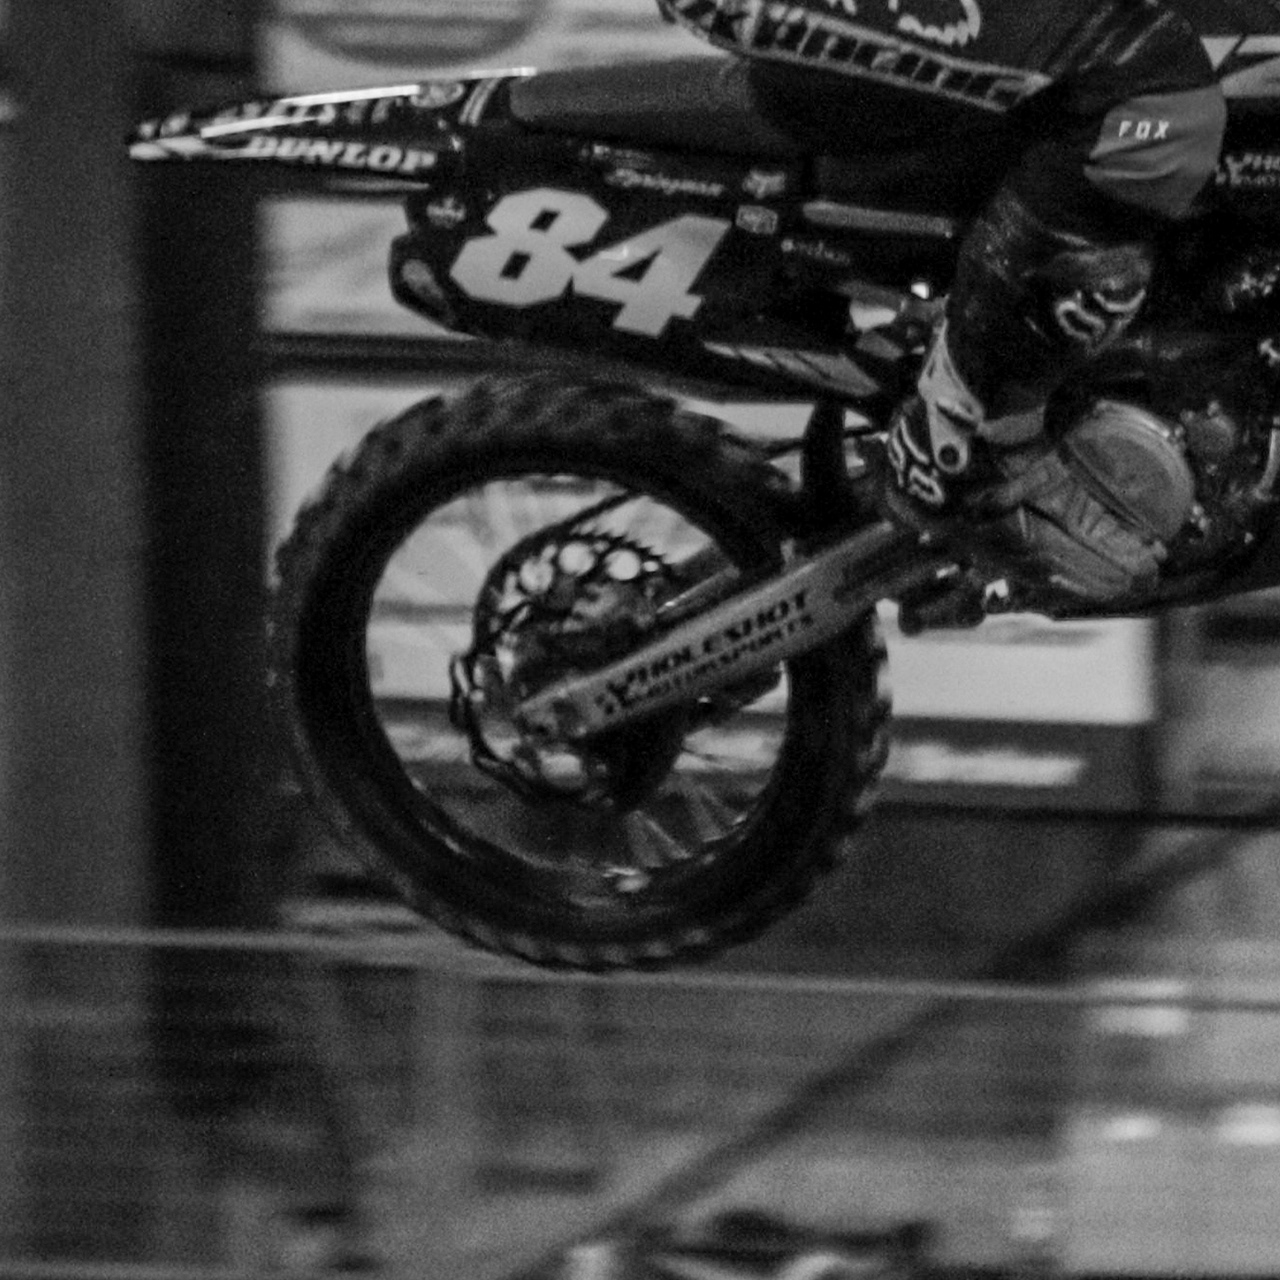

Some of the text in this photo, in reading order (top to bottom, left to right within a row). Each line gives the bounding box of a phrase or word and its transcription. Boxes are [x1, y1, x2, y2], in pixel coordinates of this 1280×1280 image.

[1118, 120, 1171, 140] FOX
[247, 135, 438, 173] DUNLOP
[449, 187, 732, 339] 84
